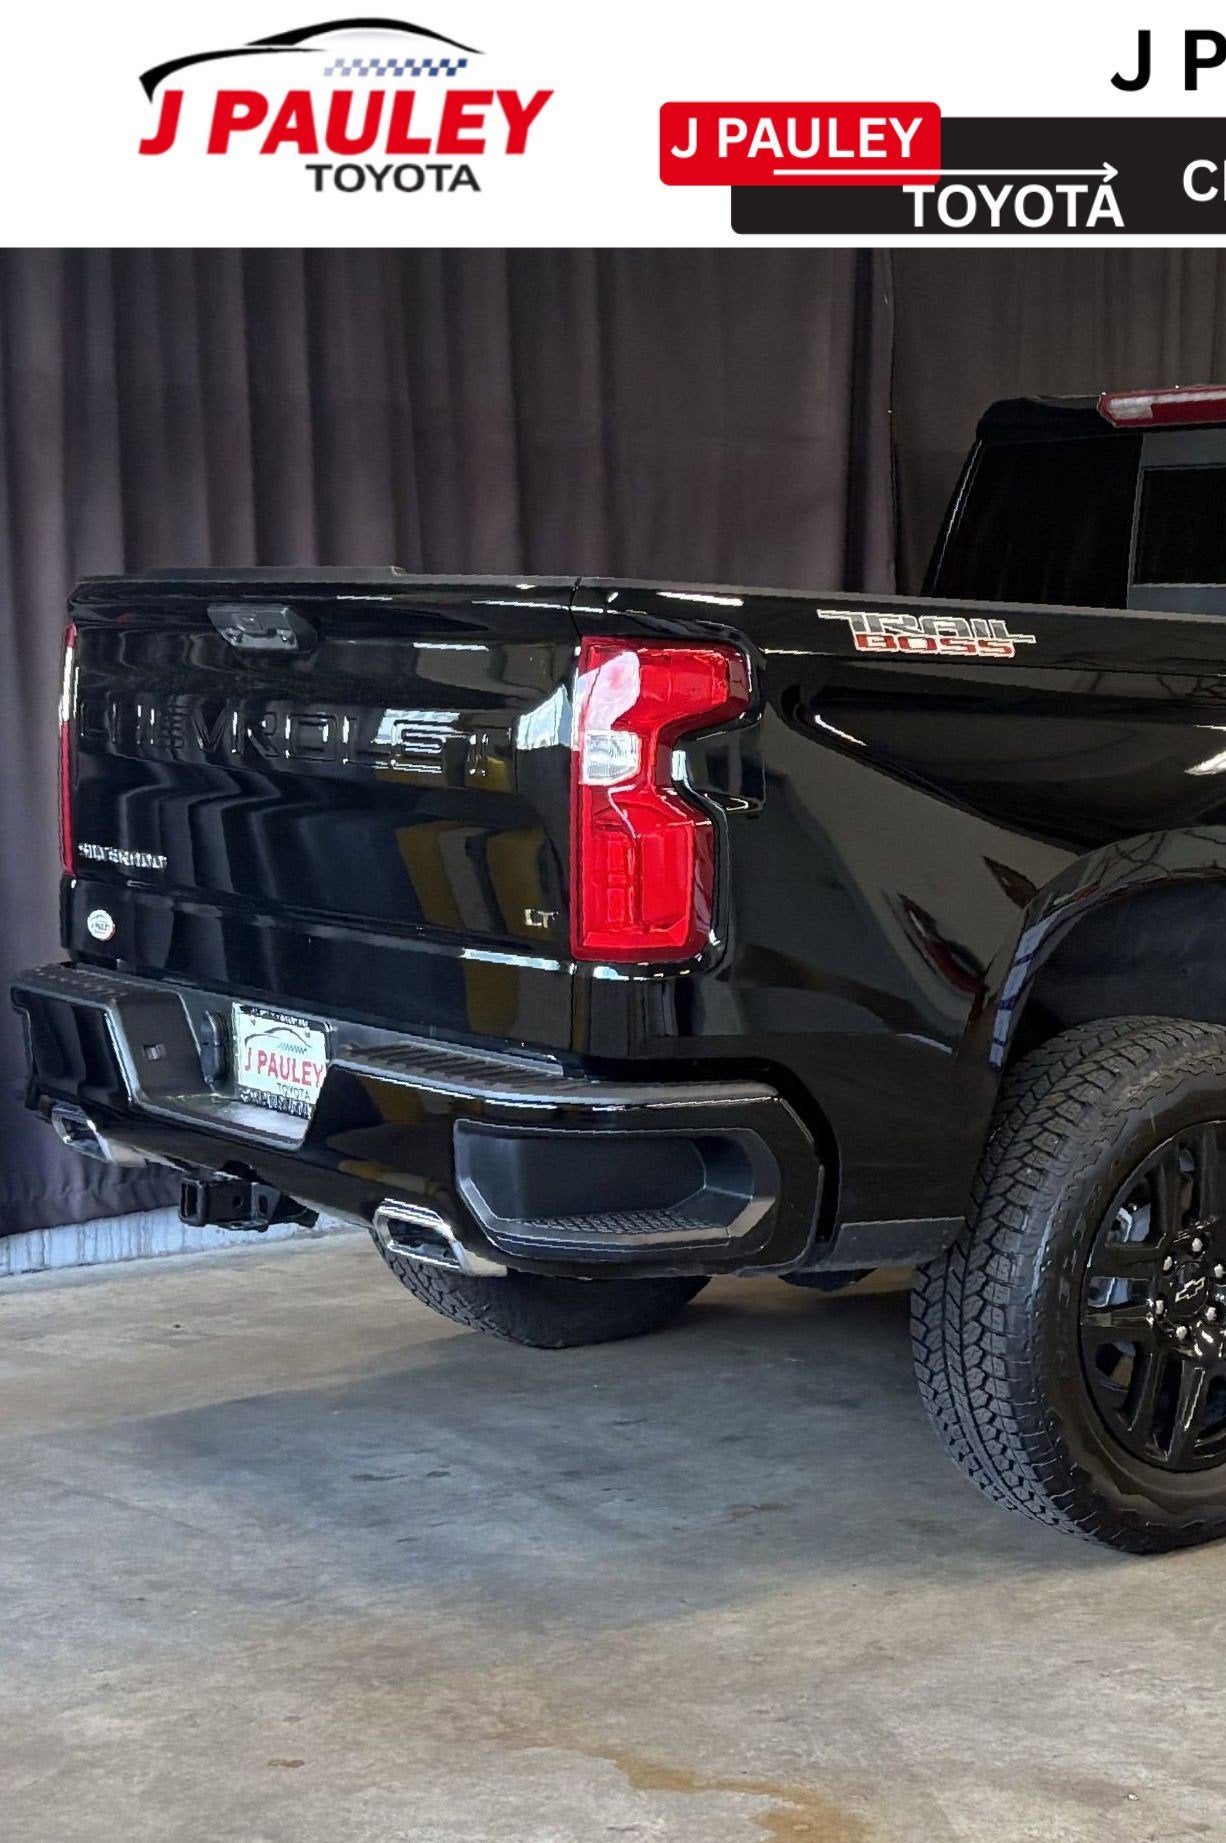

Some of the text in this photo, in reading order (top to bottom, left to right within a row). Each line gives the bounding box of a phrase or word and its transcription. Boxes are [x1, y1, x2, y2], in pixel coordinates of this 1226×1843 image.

[816, 608, 1037, 644] TRAIL
[854, 632, 1015, 658] BOSS
[525, 908, 554, 928] LT
[244, 1047, 323, 1088] J PAULEY
[276, 1082, 311, 1101] TOYOTA
